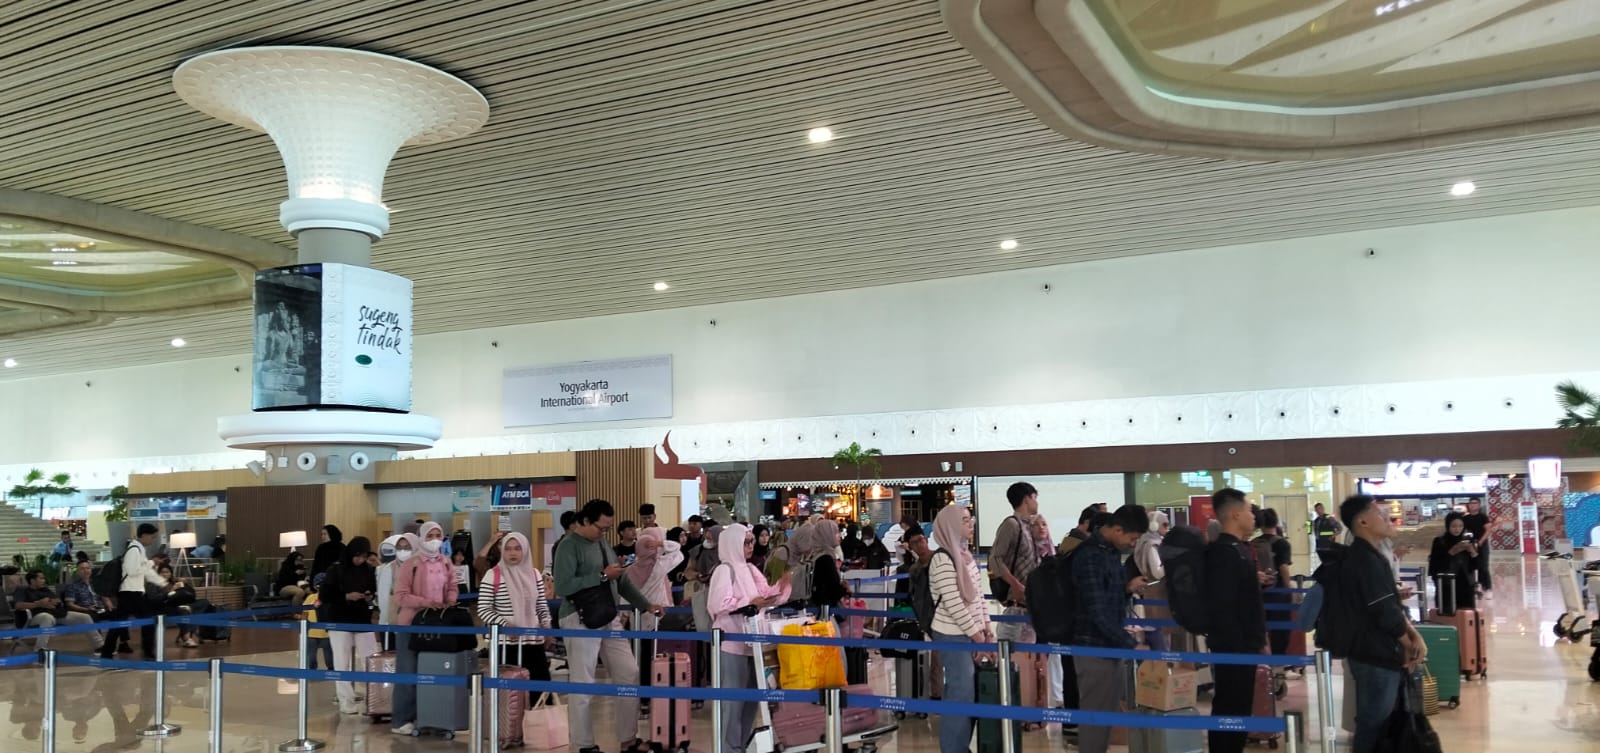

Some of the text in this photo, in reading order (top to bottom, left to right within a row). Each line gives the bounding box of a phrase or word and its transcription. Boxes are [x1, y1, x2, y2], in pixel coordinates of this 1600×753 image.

[358, 305, 403, 332] sugeng
[560, 380, 608, 395] Yogyakarta
[540, 392, 629, 408] International Airport
[1384, 461, 1452, 481] KFC
[517, 490, 529, 498] BCA
